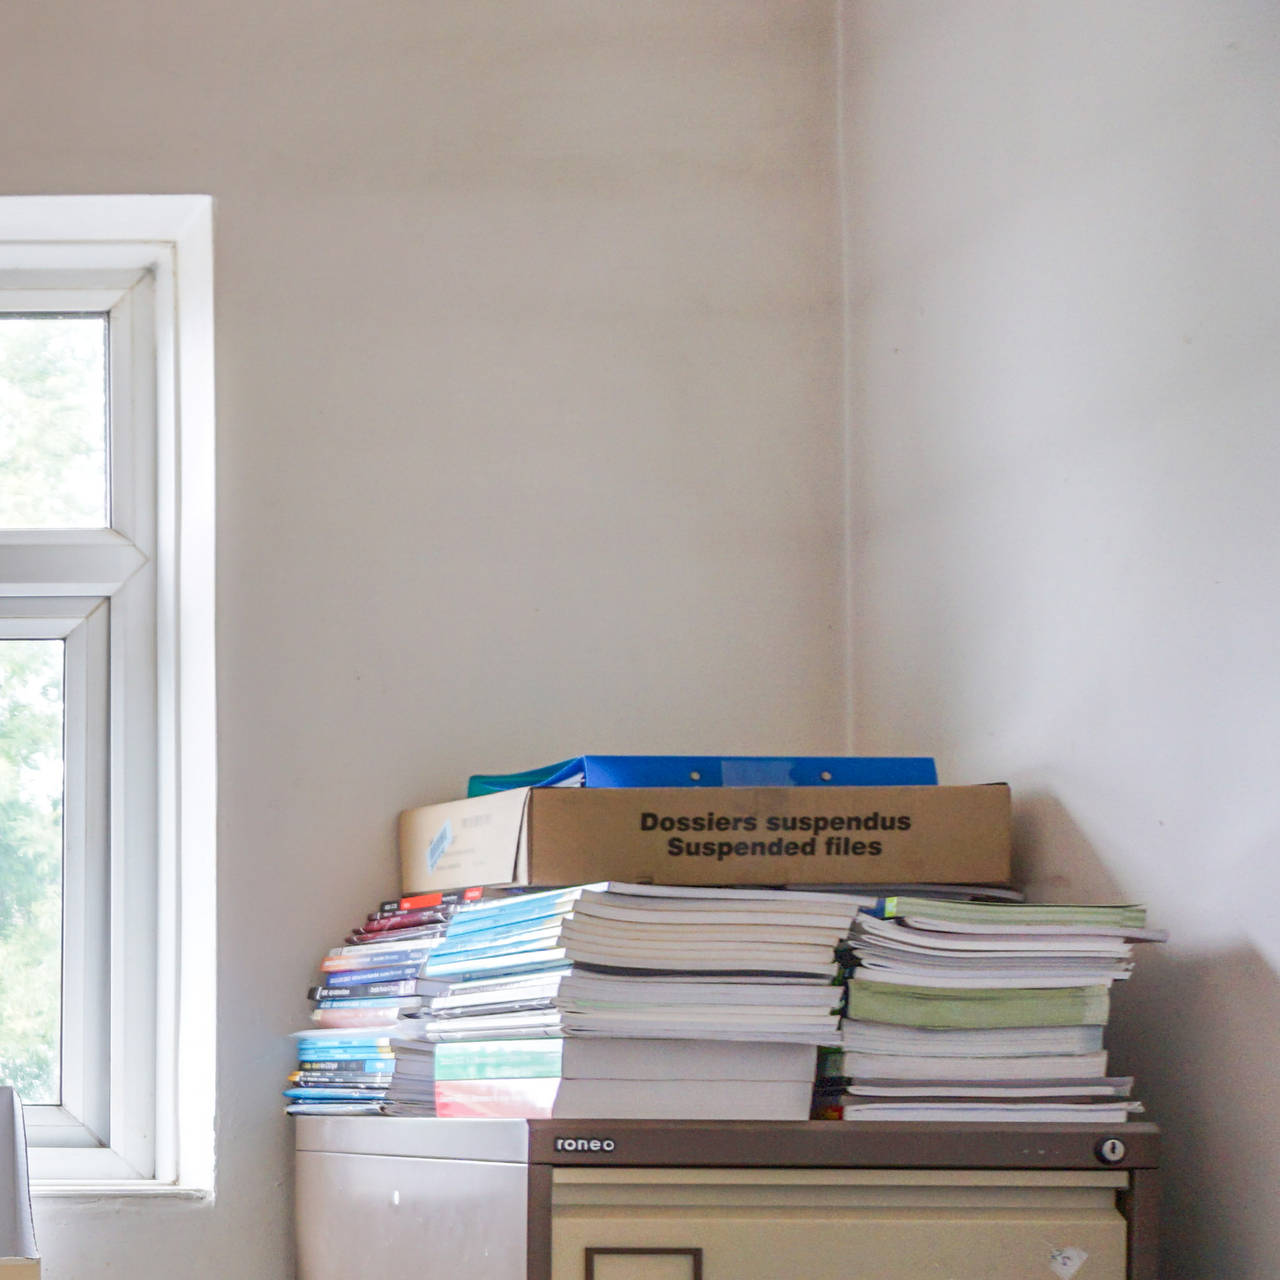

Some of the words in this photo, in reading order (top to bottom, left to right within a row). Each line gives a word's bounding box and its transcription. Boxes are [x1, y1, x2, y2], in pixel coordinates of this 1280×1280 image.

[640, 812, 757, 831] Dossiers
[766, 812, 911, 835] suspendus
[667, 837, 816, 861] Suspended
[825, 837, 882, 856] files
[557, 1139, 615, 1151] roneo
